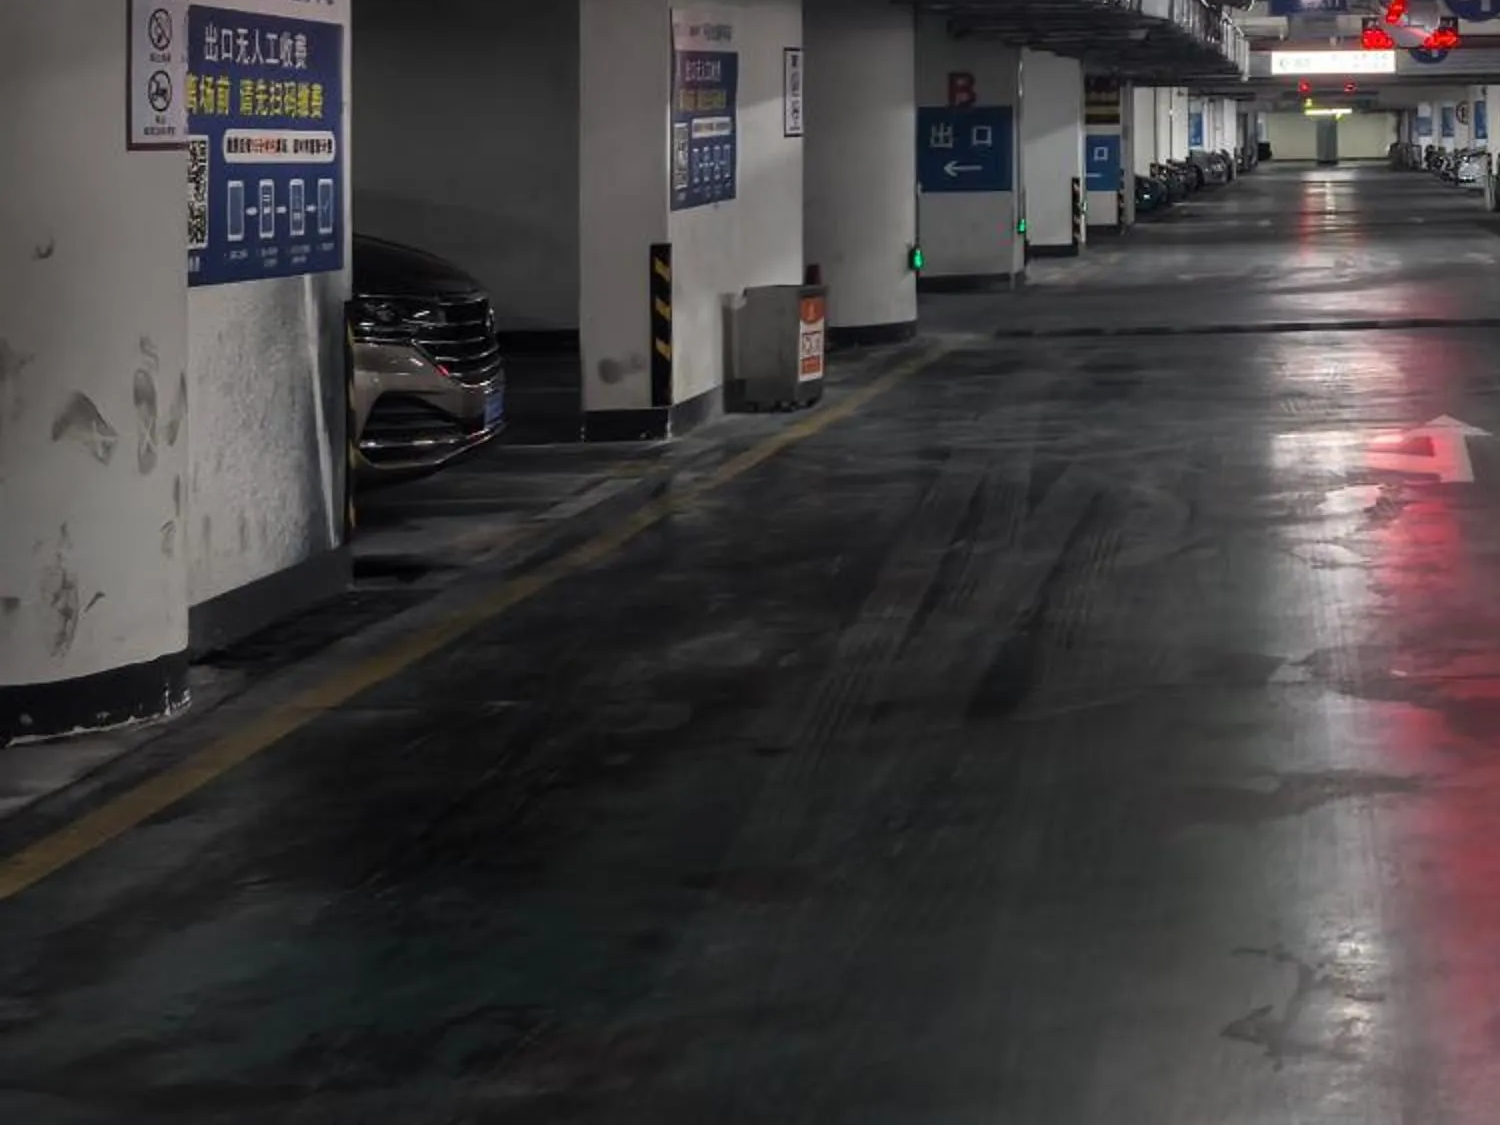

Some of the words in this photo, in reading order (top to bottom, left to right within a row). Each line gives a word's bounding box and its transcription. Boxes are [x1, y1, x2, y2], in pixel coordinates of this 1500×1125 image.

[204, 23, 307, 69] 出口无人工收费
[949, 72, 977, 107] B
[929, 122, 992, 148] 出口
